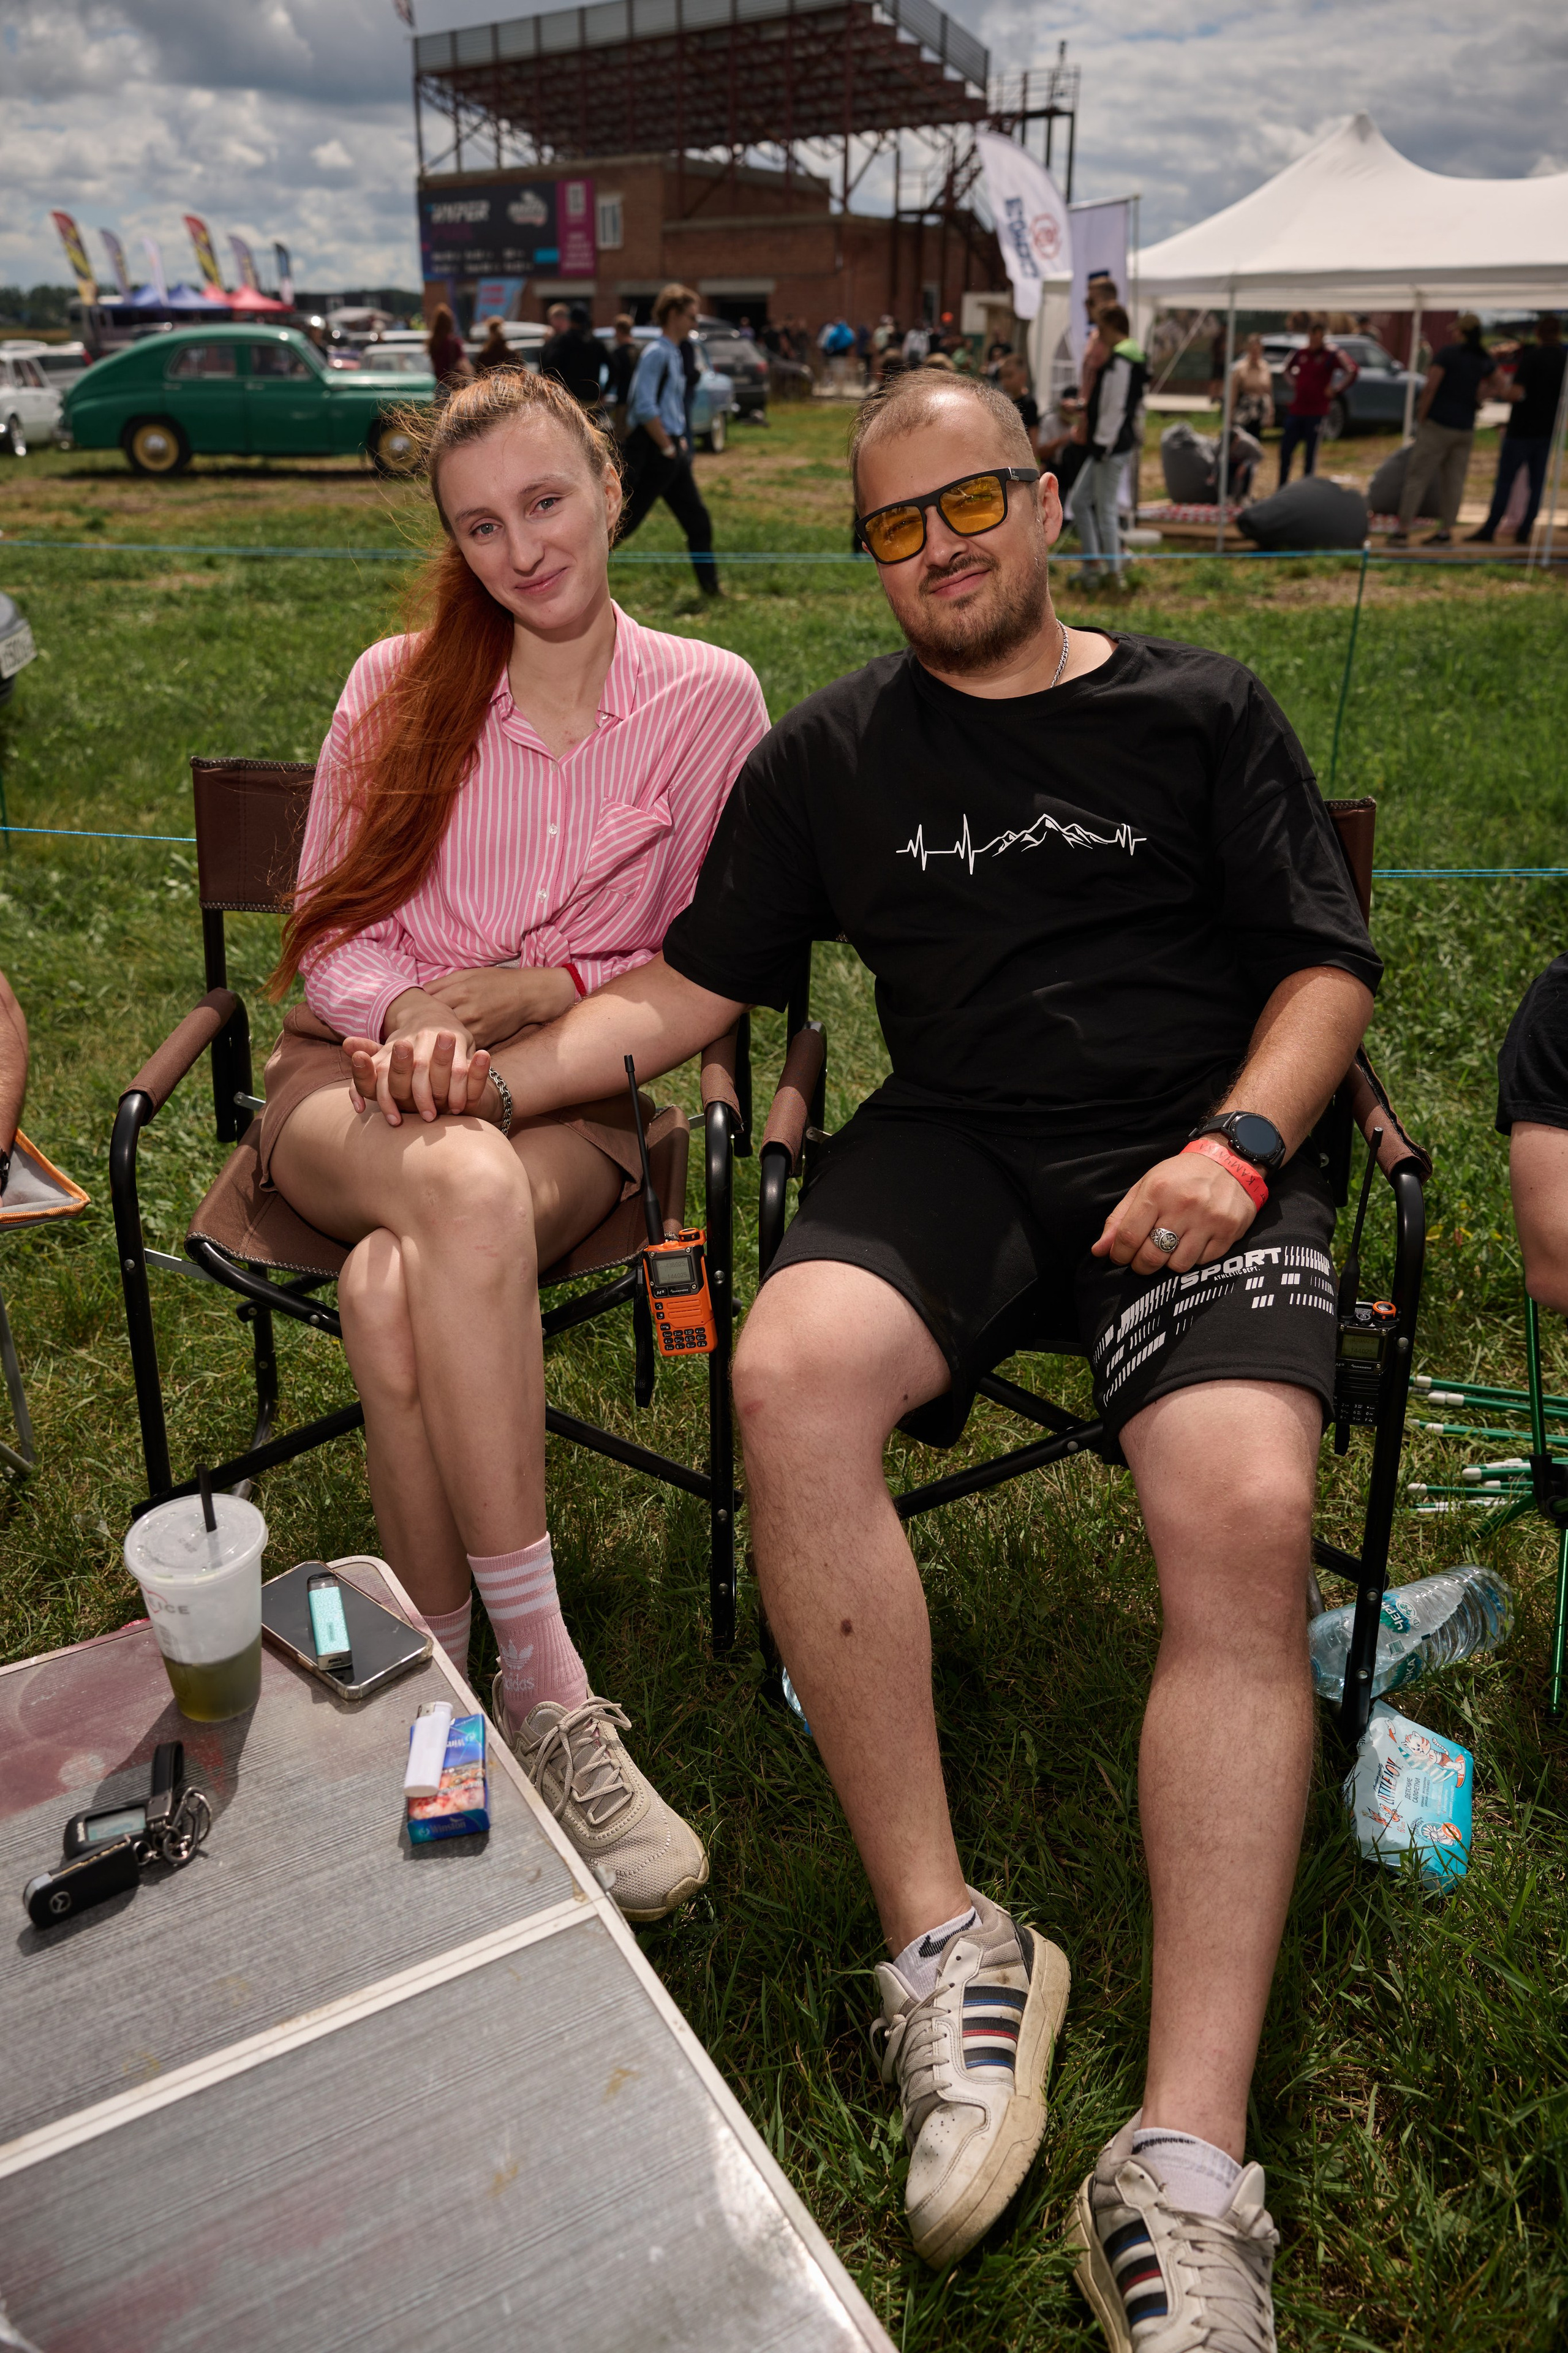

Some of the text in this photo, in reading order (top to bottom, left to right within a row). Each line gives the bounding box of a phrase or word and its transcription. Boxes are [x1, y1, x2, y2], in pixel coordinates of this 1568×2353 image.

[1181, 1247, 1281, 1290] SPORT
[1214, 1270, 1242, 1281] ATHLETIC
[502, 1674, 535, 1692] adidas
[1412, 1777, 1420, 1803] САЛФЕТКИ
[429, 1821, 467, 1834] Winston
